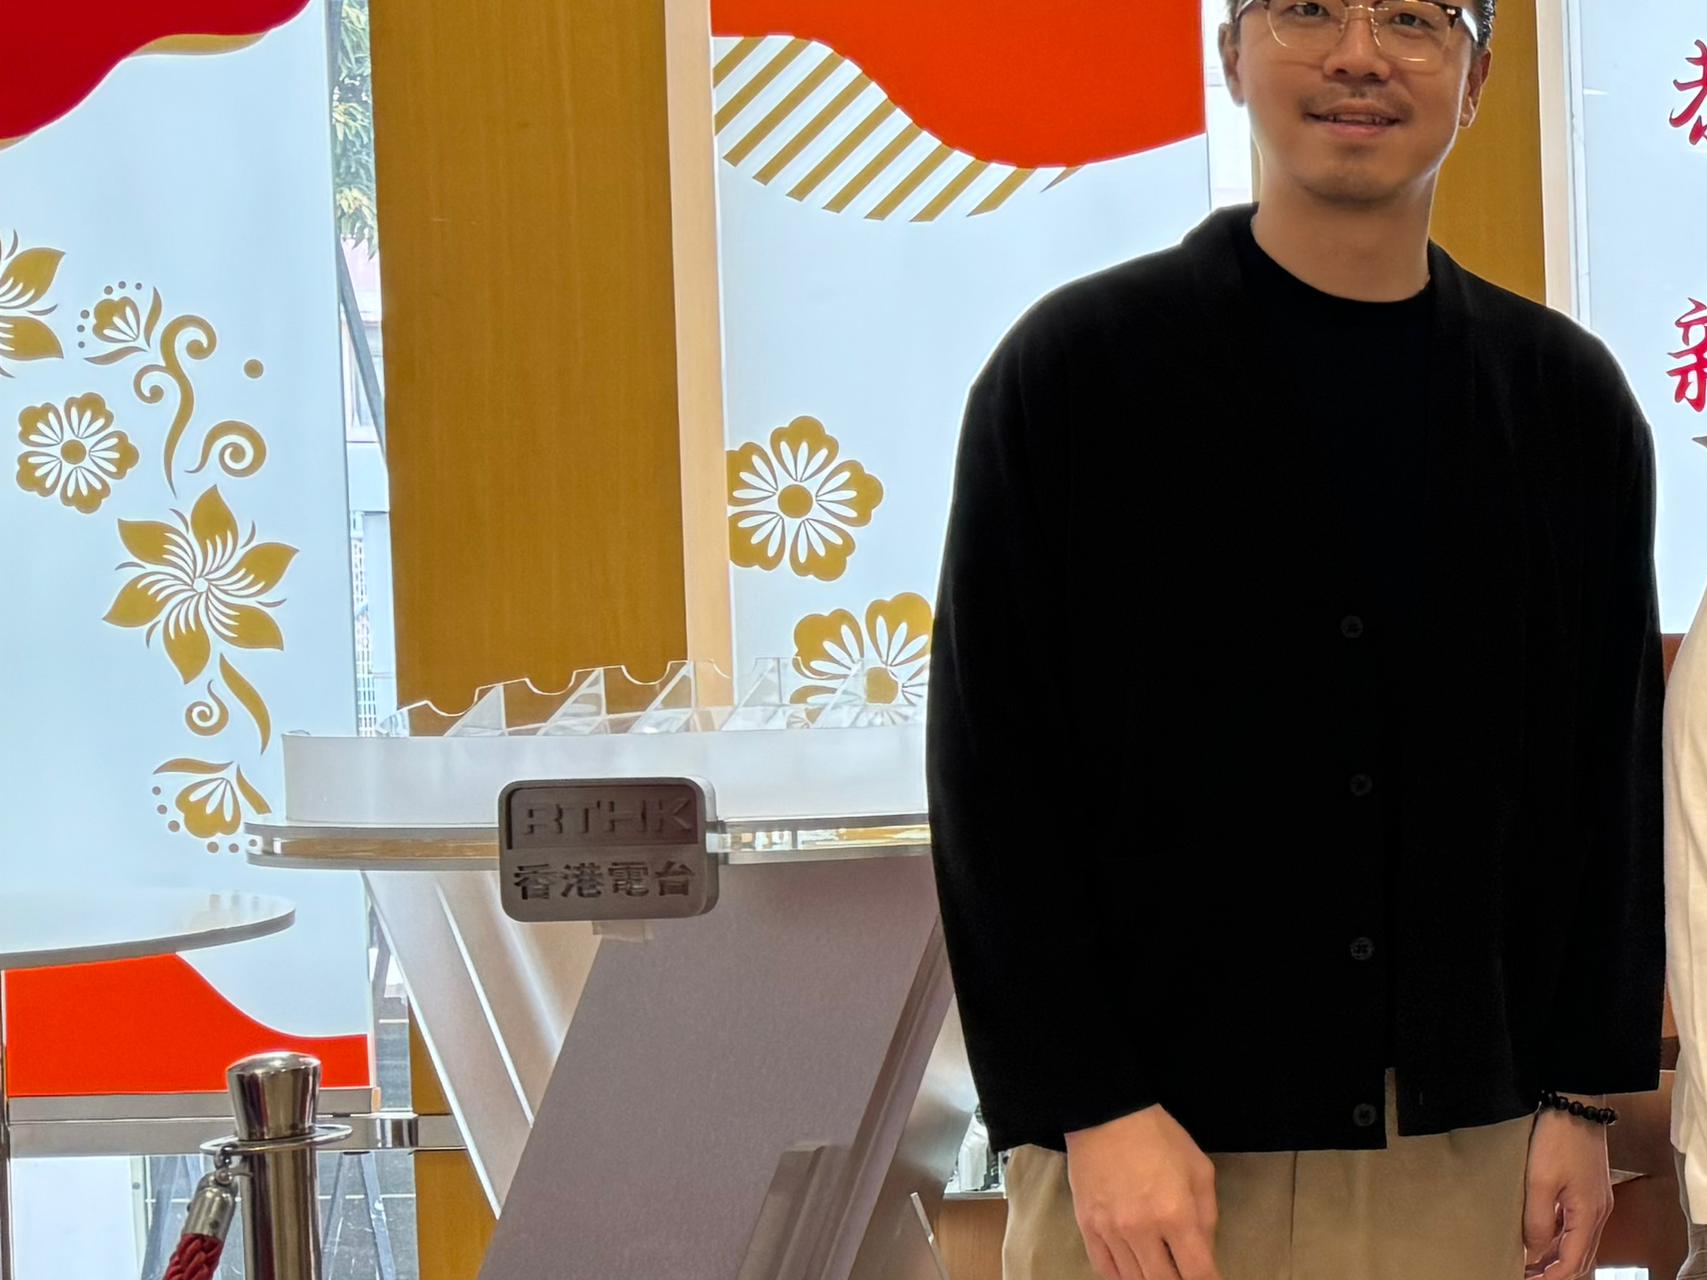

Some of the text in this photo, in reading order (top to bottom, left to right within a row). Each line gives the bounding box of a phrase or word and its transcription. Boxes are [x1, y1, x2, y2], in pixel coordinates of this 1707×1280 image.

[517, 798, 692, 836] RTHK
[514, 860, 696, 901] 香港電台
